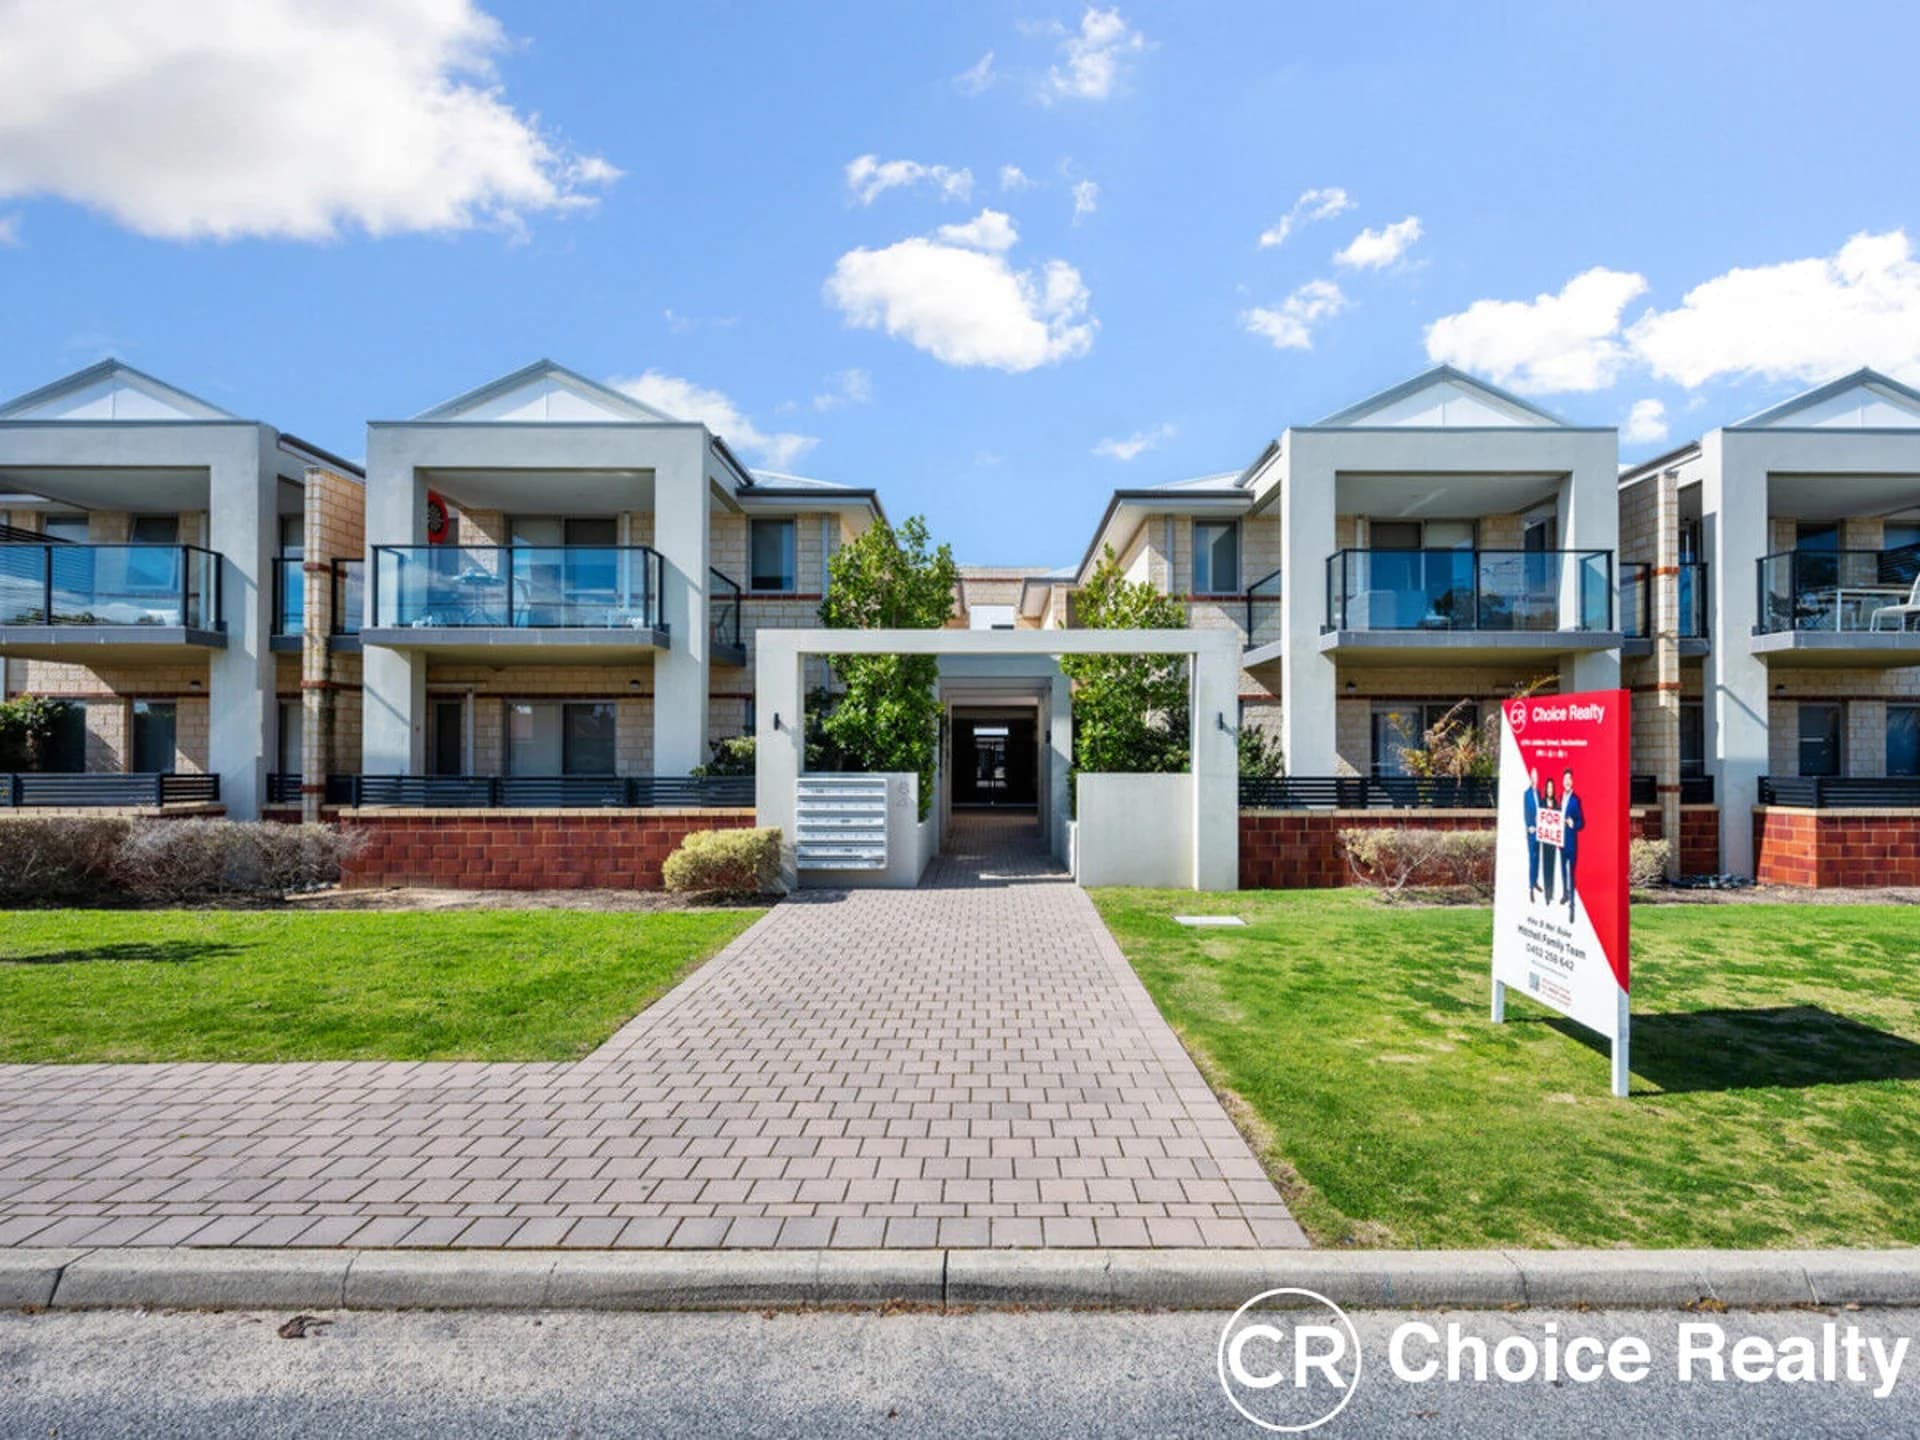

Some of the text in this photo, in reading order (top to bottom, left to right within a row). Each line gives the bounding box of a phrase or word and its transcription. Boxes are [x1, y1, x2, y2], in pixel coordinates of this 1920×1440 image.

[1532, 703, 1605, 724] Choice Realty
[1540, 811, 1560, 826] FOR
[1538, 827, 1562, 844] SALE
[1542, 934, 1564, 953] Family
[1565, 943, 1587, 960] Team
